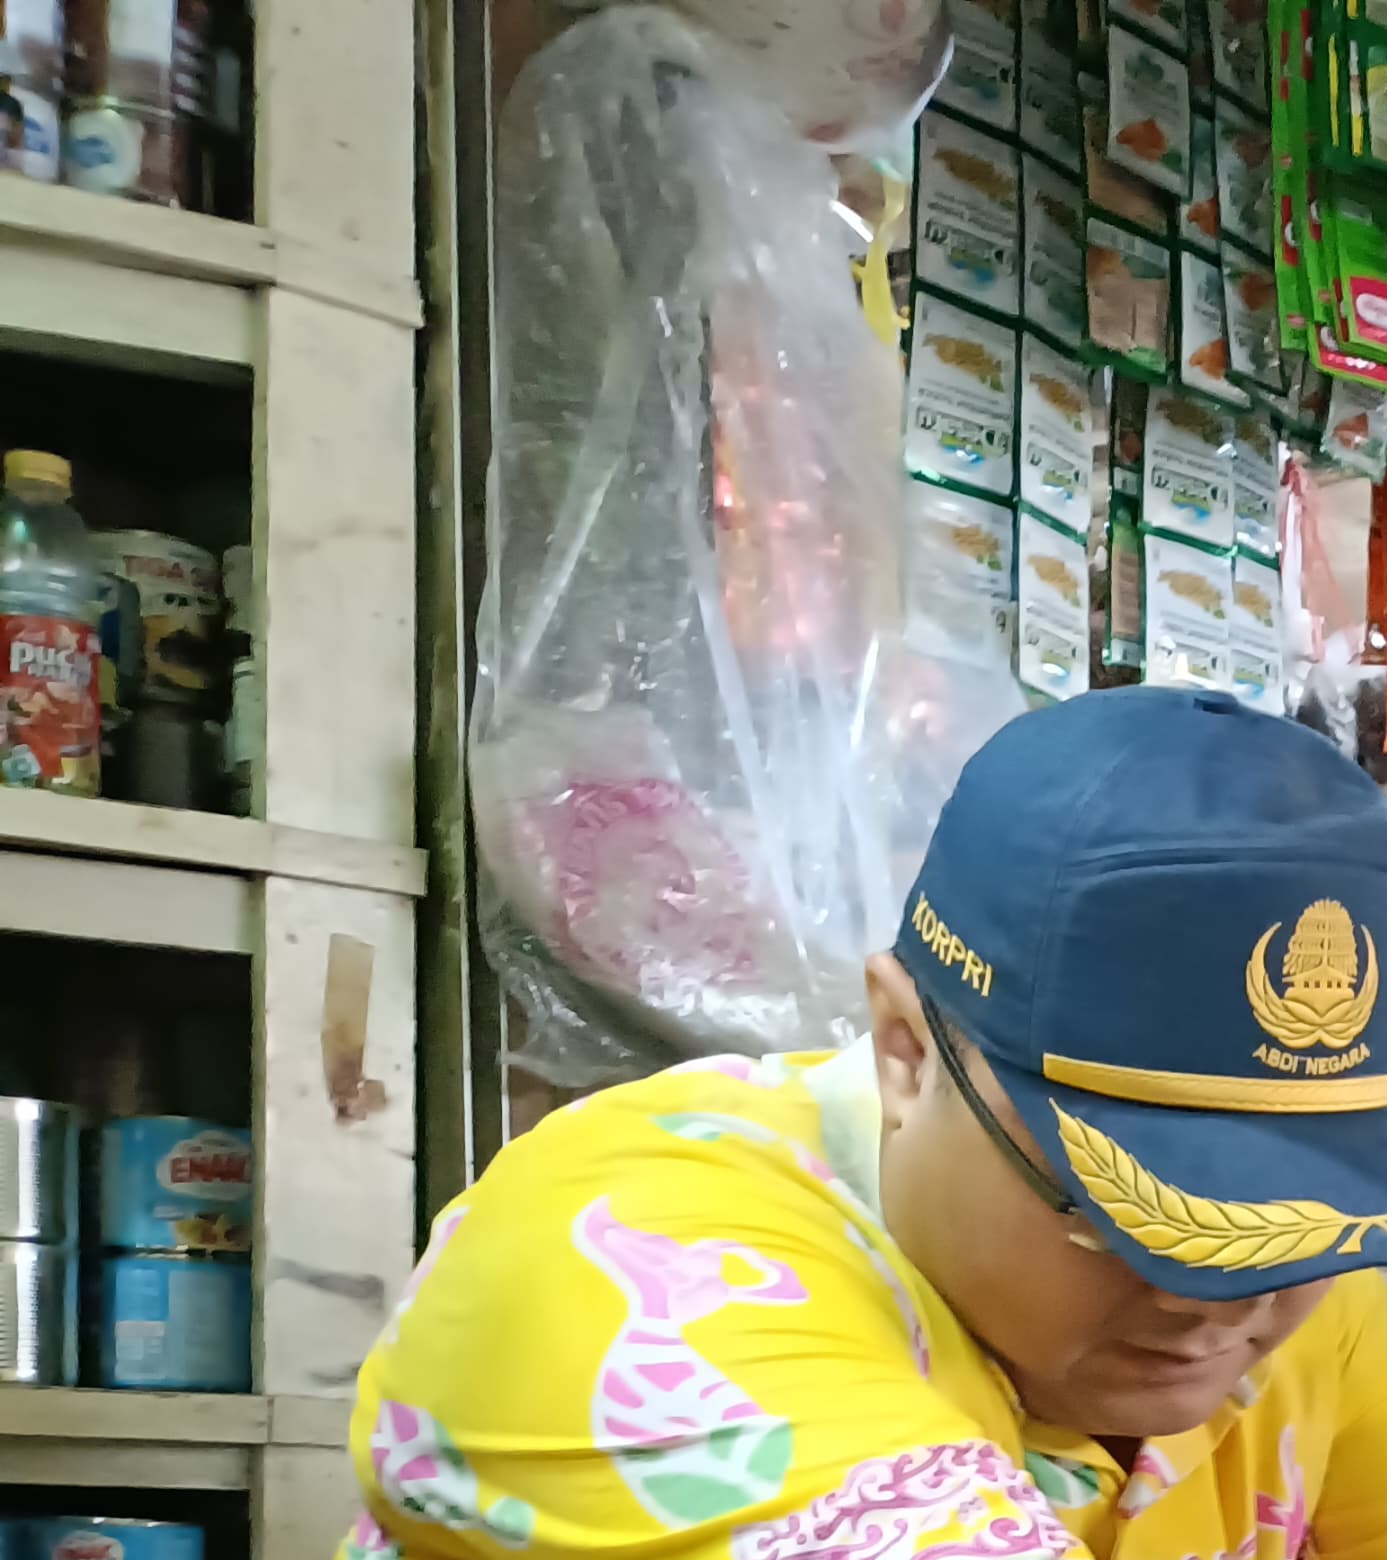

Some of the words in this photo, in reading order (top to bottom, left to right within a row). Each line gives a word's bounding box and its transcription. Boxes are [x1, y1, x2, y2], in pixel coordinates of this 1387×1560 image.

[912, 890, 992, 996] KORPRI
[1252, 1043, 1299, 1073] ABDI
[1305, 1043, 1371, 1075] NEGARA
